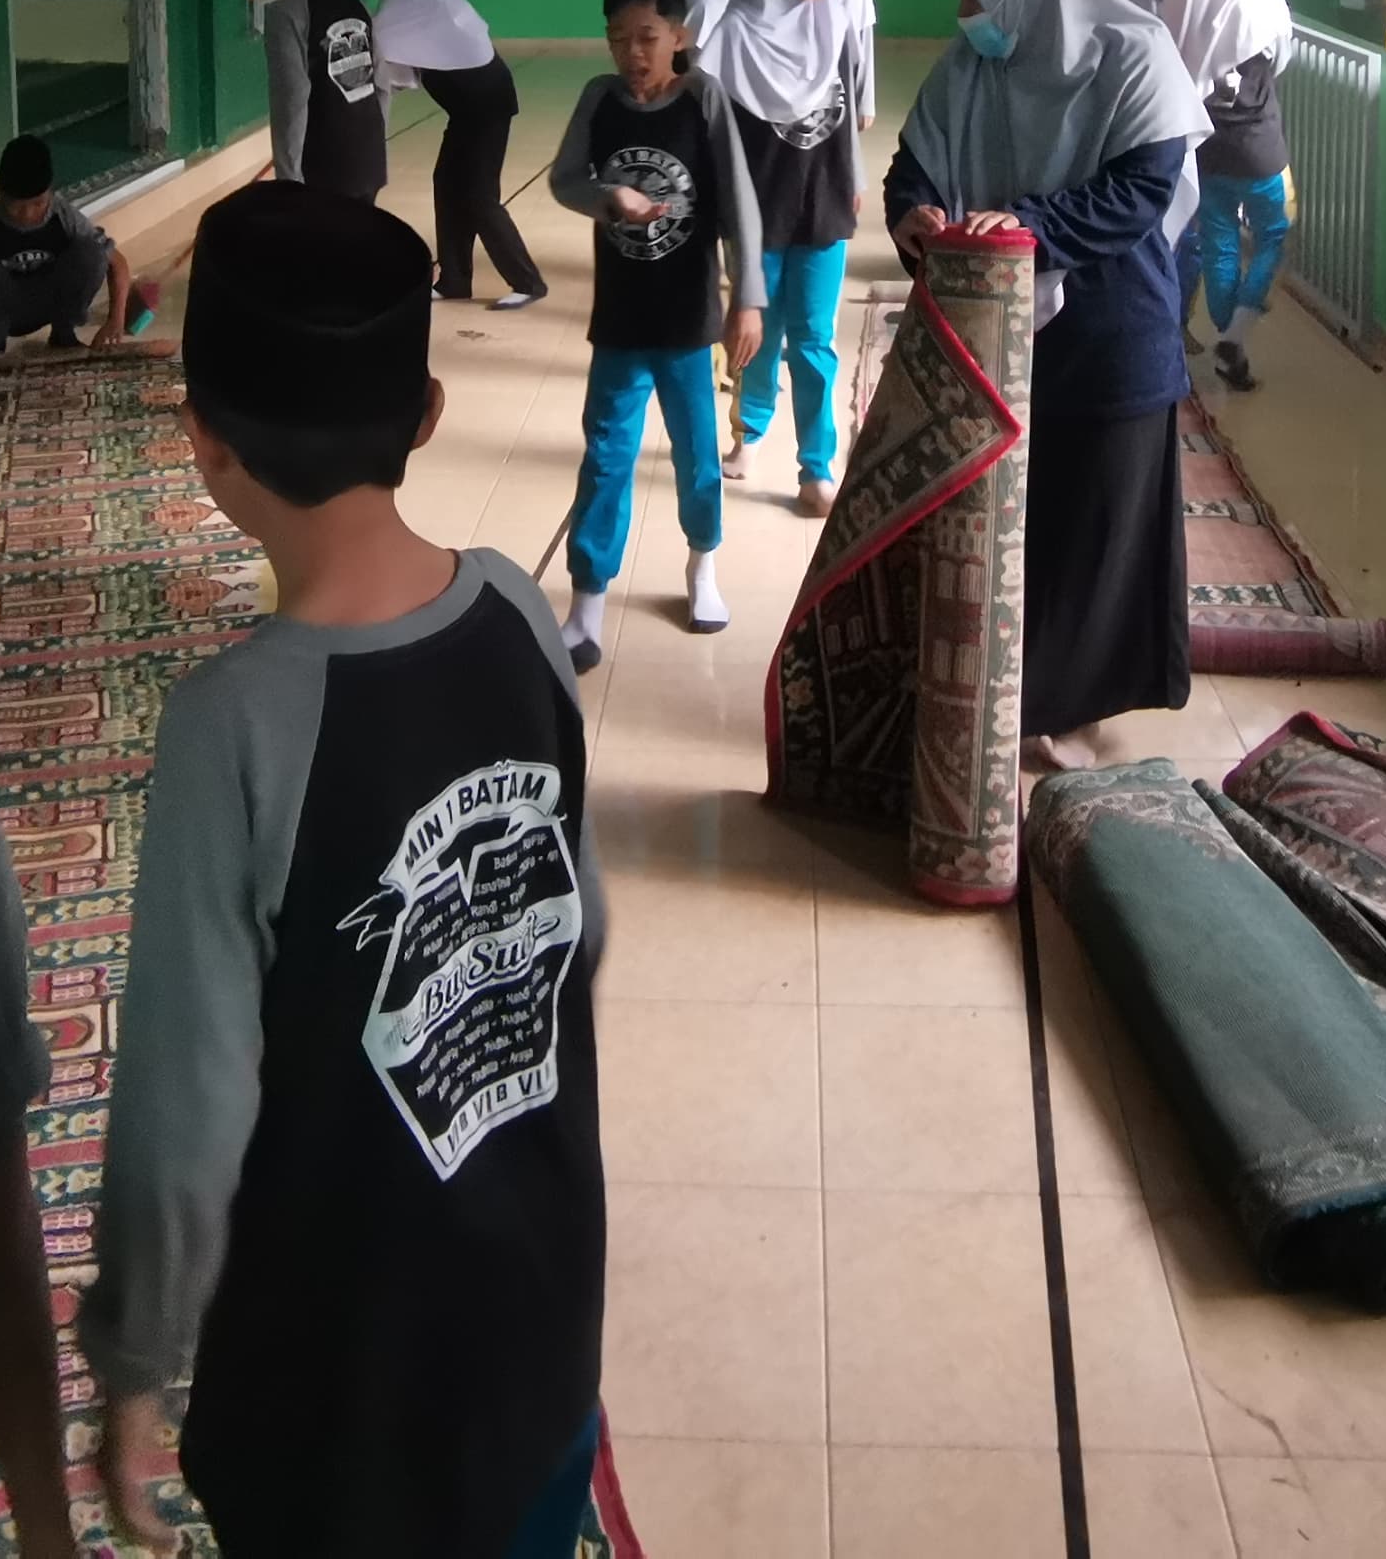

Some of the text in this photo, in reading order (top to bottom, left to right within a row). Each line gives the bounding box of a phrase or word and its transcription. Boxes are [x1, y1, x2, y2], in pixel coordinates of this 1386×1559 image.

[457, 771, 547, 817] BATAM
[422, 965, 463, 1023] Bu
[472, 1083, 508, 1120] VIB
